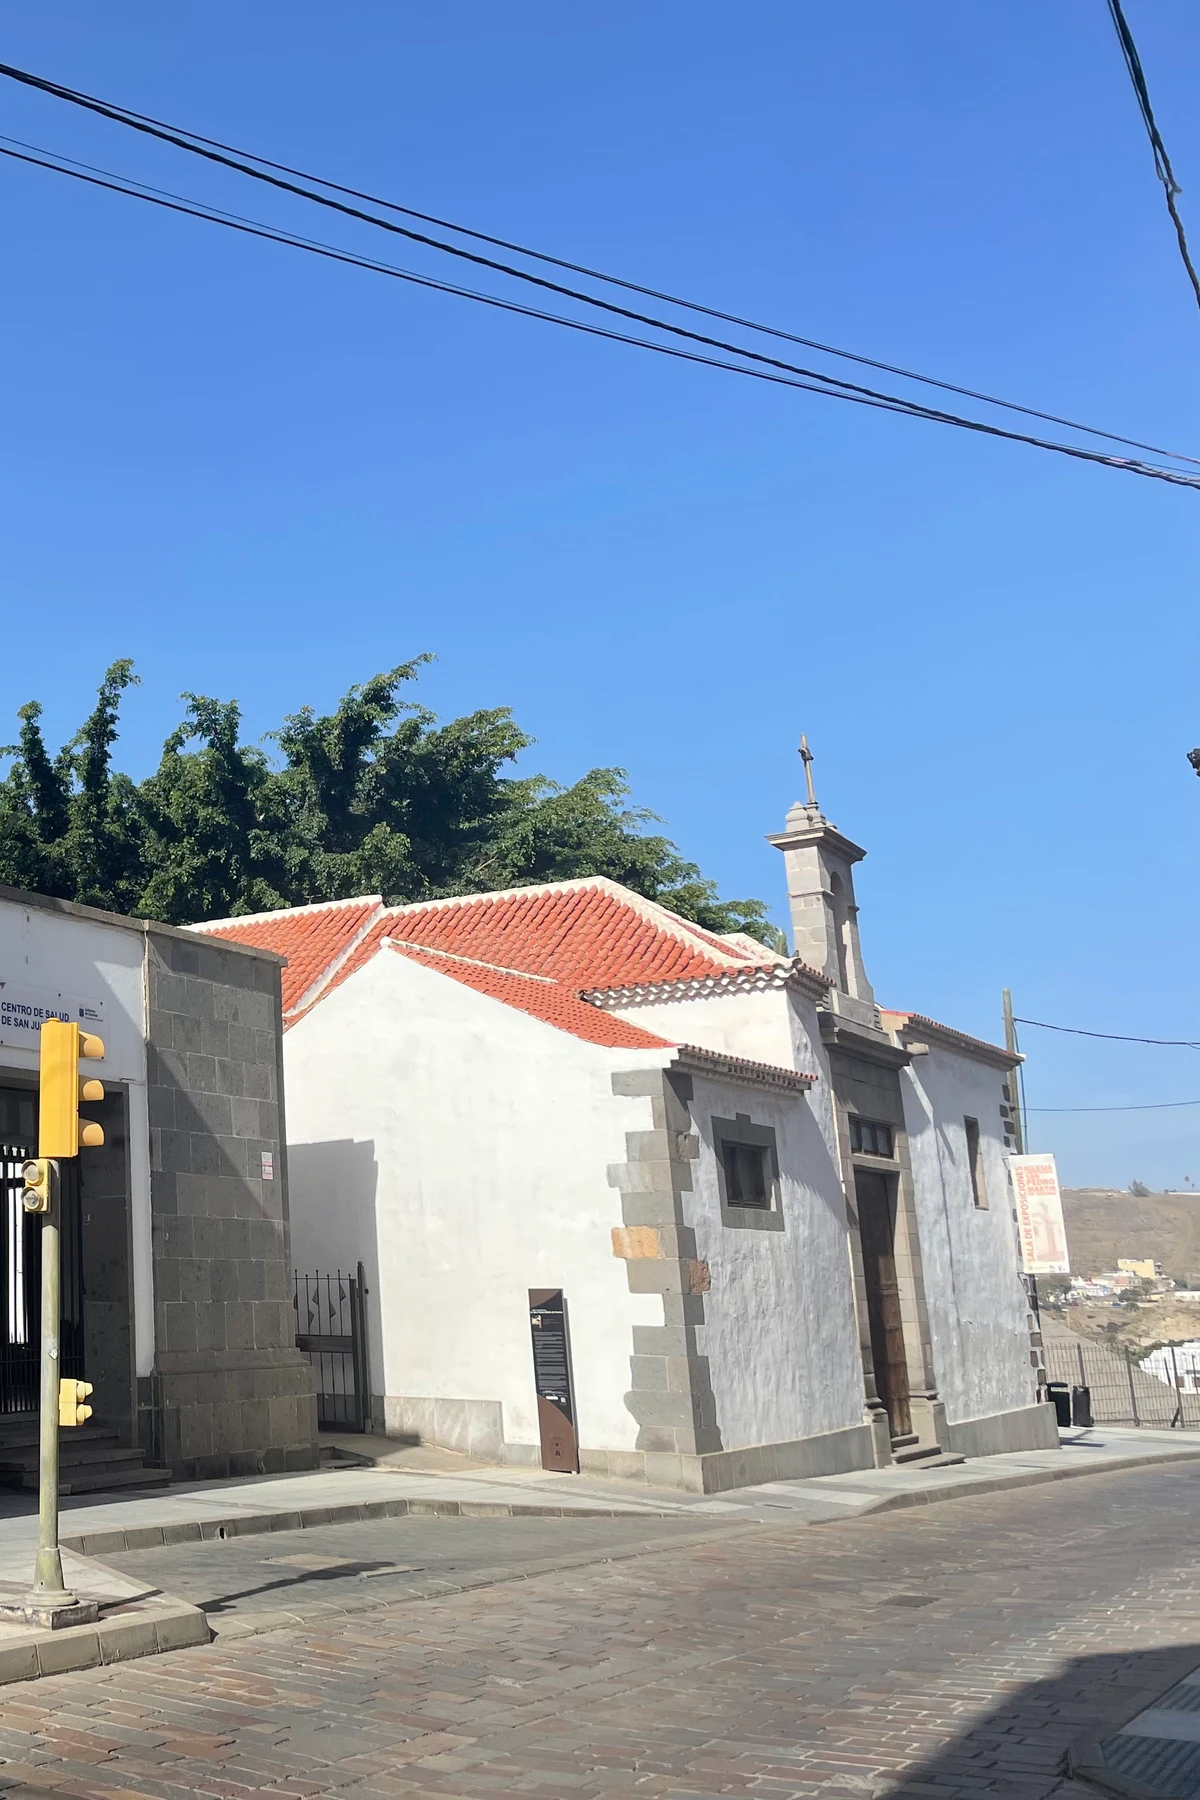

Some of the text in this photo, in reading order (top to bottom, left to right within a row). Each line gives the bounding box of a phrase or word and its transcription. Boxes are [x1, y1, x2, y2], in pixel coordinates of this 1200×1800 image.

[1, 1001, 32, 1016] CENTRO
[33, 1007, 44, 1018] DE
[45, 1009, 70, 1022] SALUD
[1, 1015, 42, 1031] DE SAN JU
[1026, 1178, 1055, 1186] PEDRO
[1015, 1166, 1036, 1263] SALA DE EXPOSICIONES
